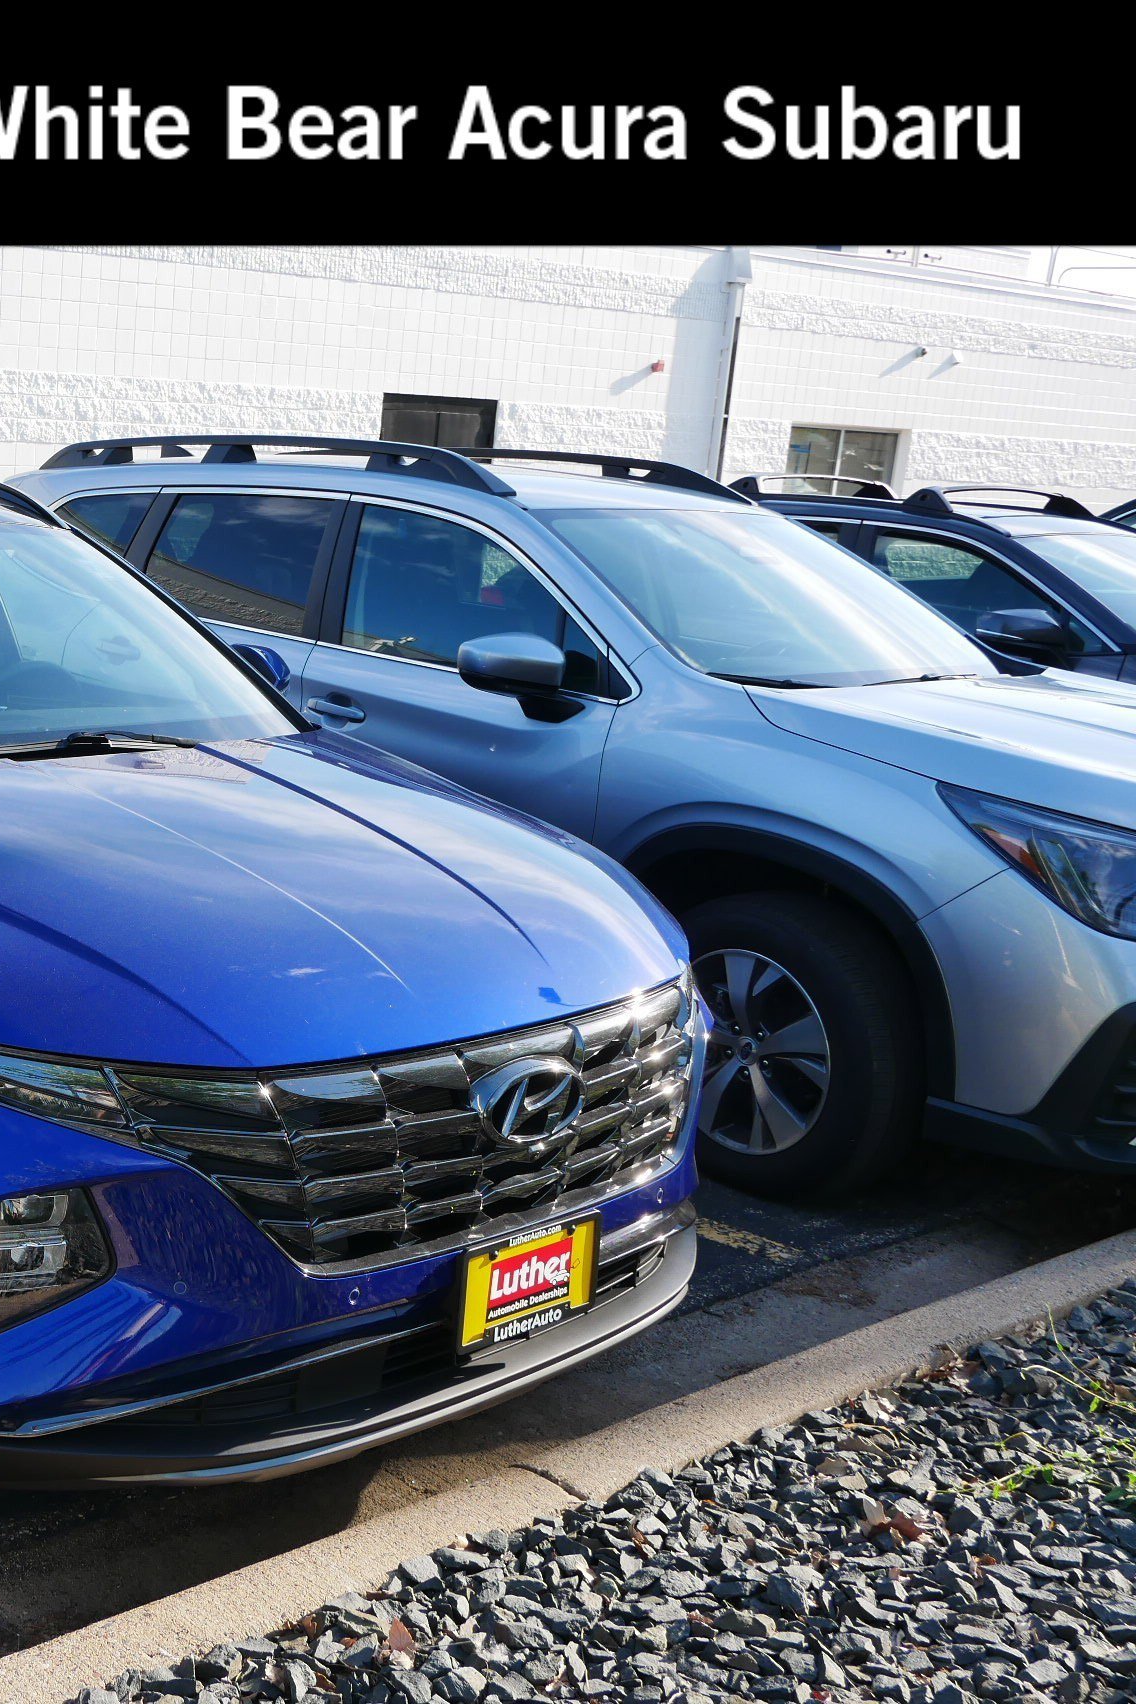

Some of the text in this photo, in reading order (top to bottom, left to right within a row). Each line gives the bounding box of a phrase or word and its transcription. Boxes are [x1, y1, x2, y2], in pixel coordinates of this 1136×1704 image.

[509, 1224, 562, 1247] LutherAuto.com
[489, 1251, 571, 1300] Luther
[487, 1286, 568, 1320] Automobile Dealerships
[493, 1308, 562, 1343] LutherAuto
